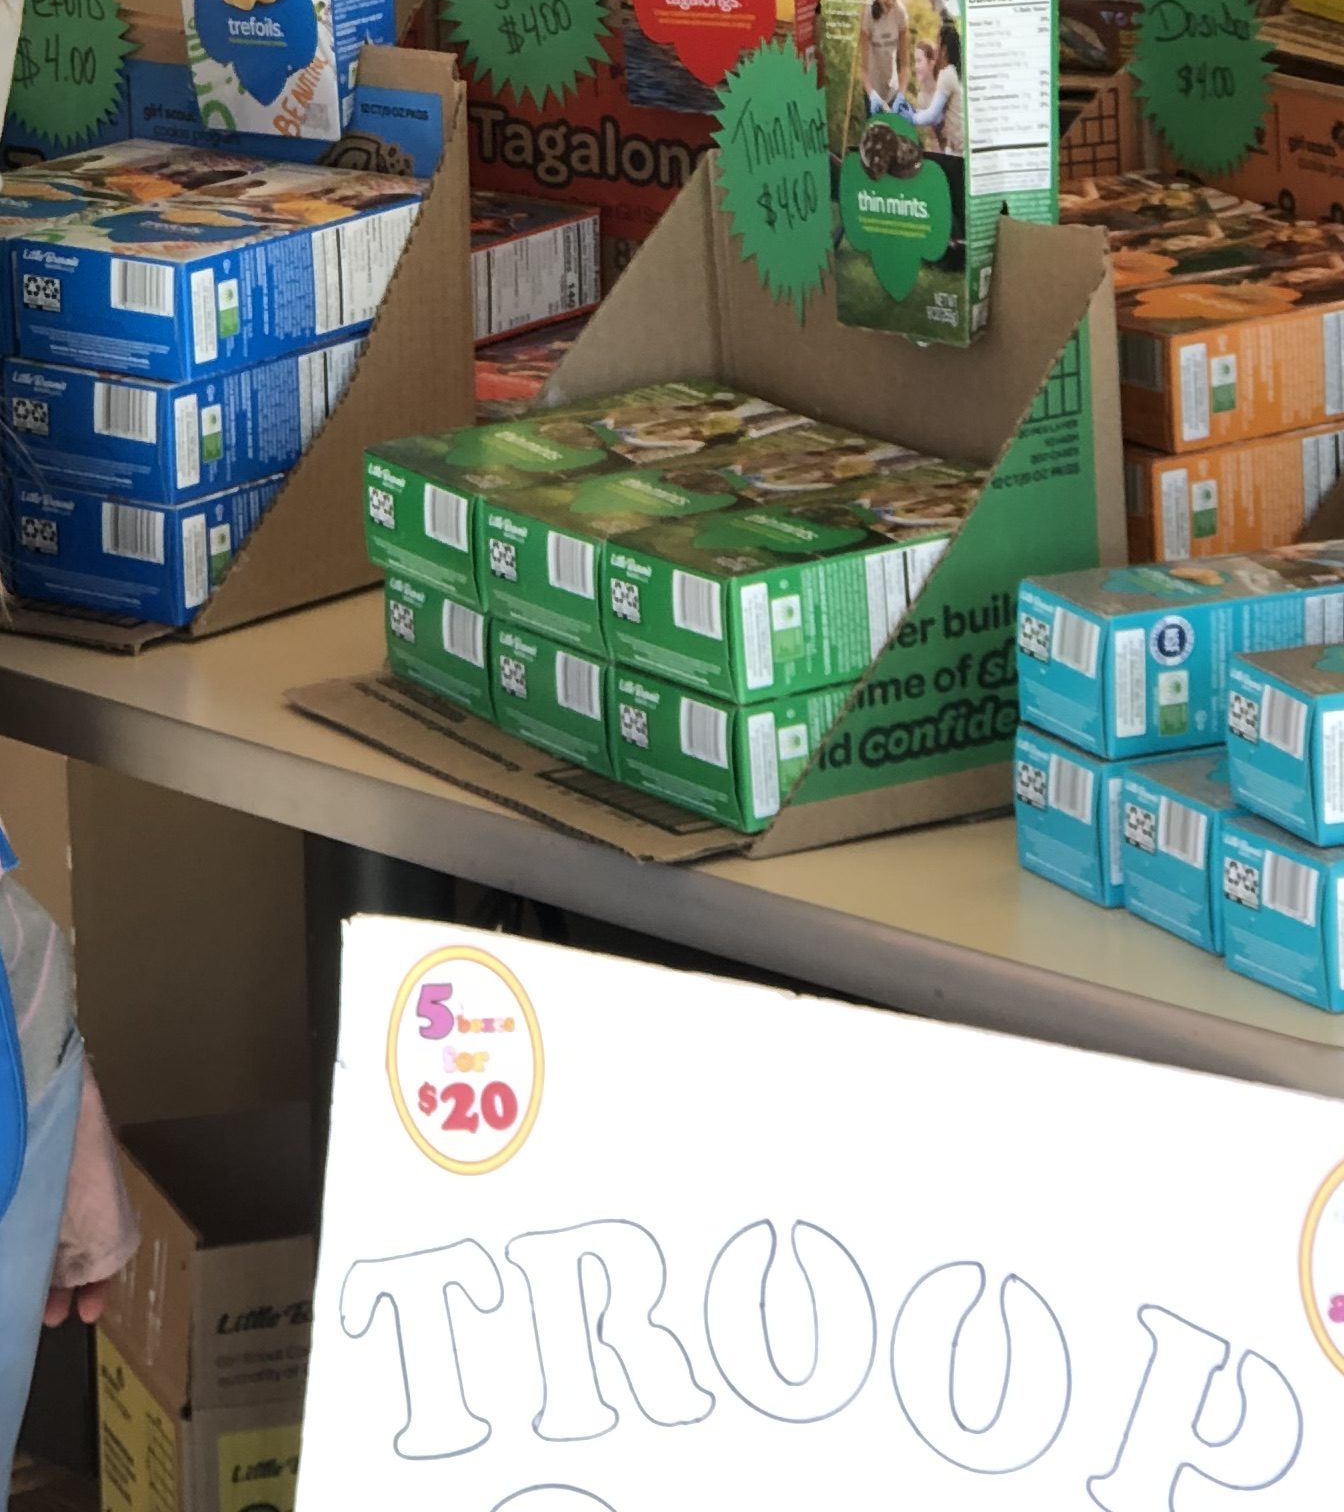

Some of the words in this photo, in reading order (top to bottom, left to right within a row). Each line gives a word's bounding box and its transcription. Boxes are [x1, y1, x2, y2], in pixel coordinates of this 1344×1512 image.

[16, 33, 96, 87] $4.00
[731, 98, 786, 175] Thin
[857, 190, 885, 214] thin
[933, 657, 974, 698] of
[415, 981, 456, 1040] 5
[417, 1080, 520, 1135] $20
[339, 1219, 1304, 1512] TROOP
